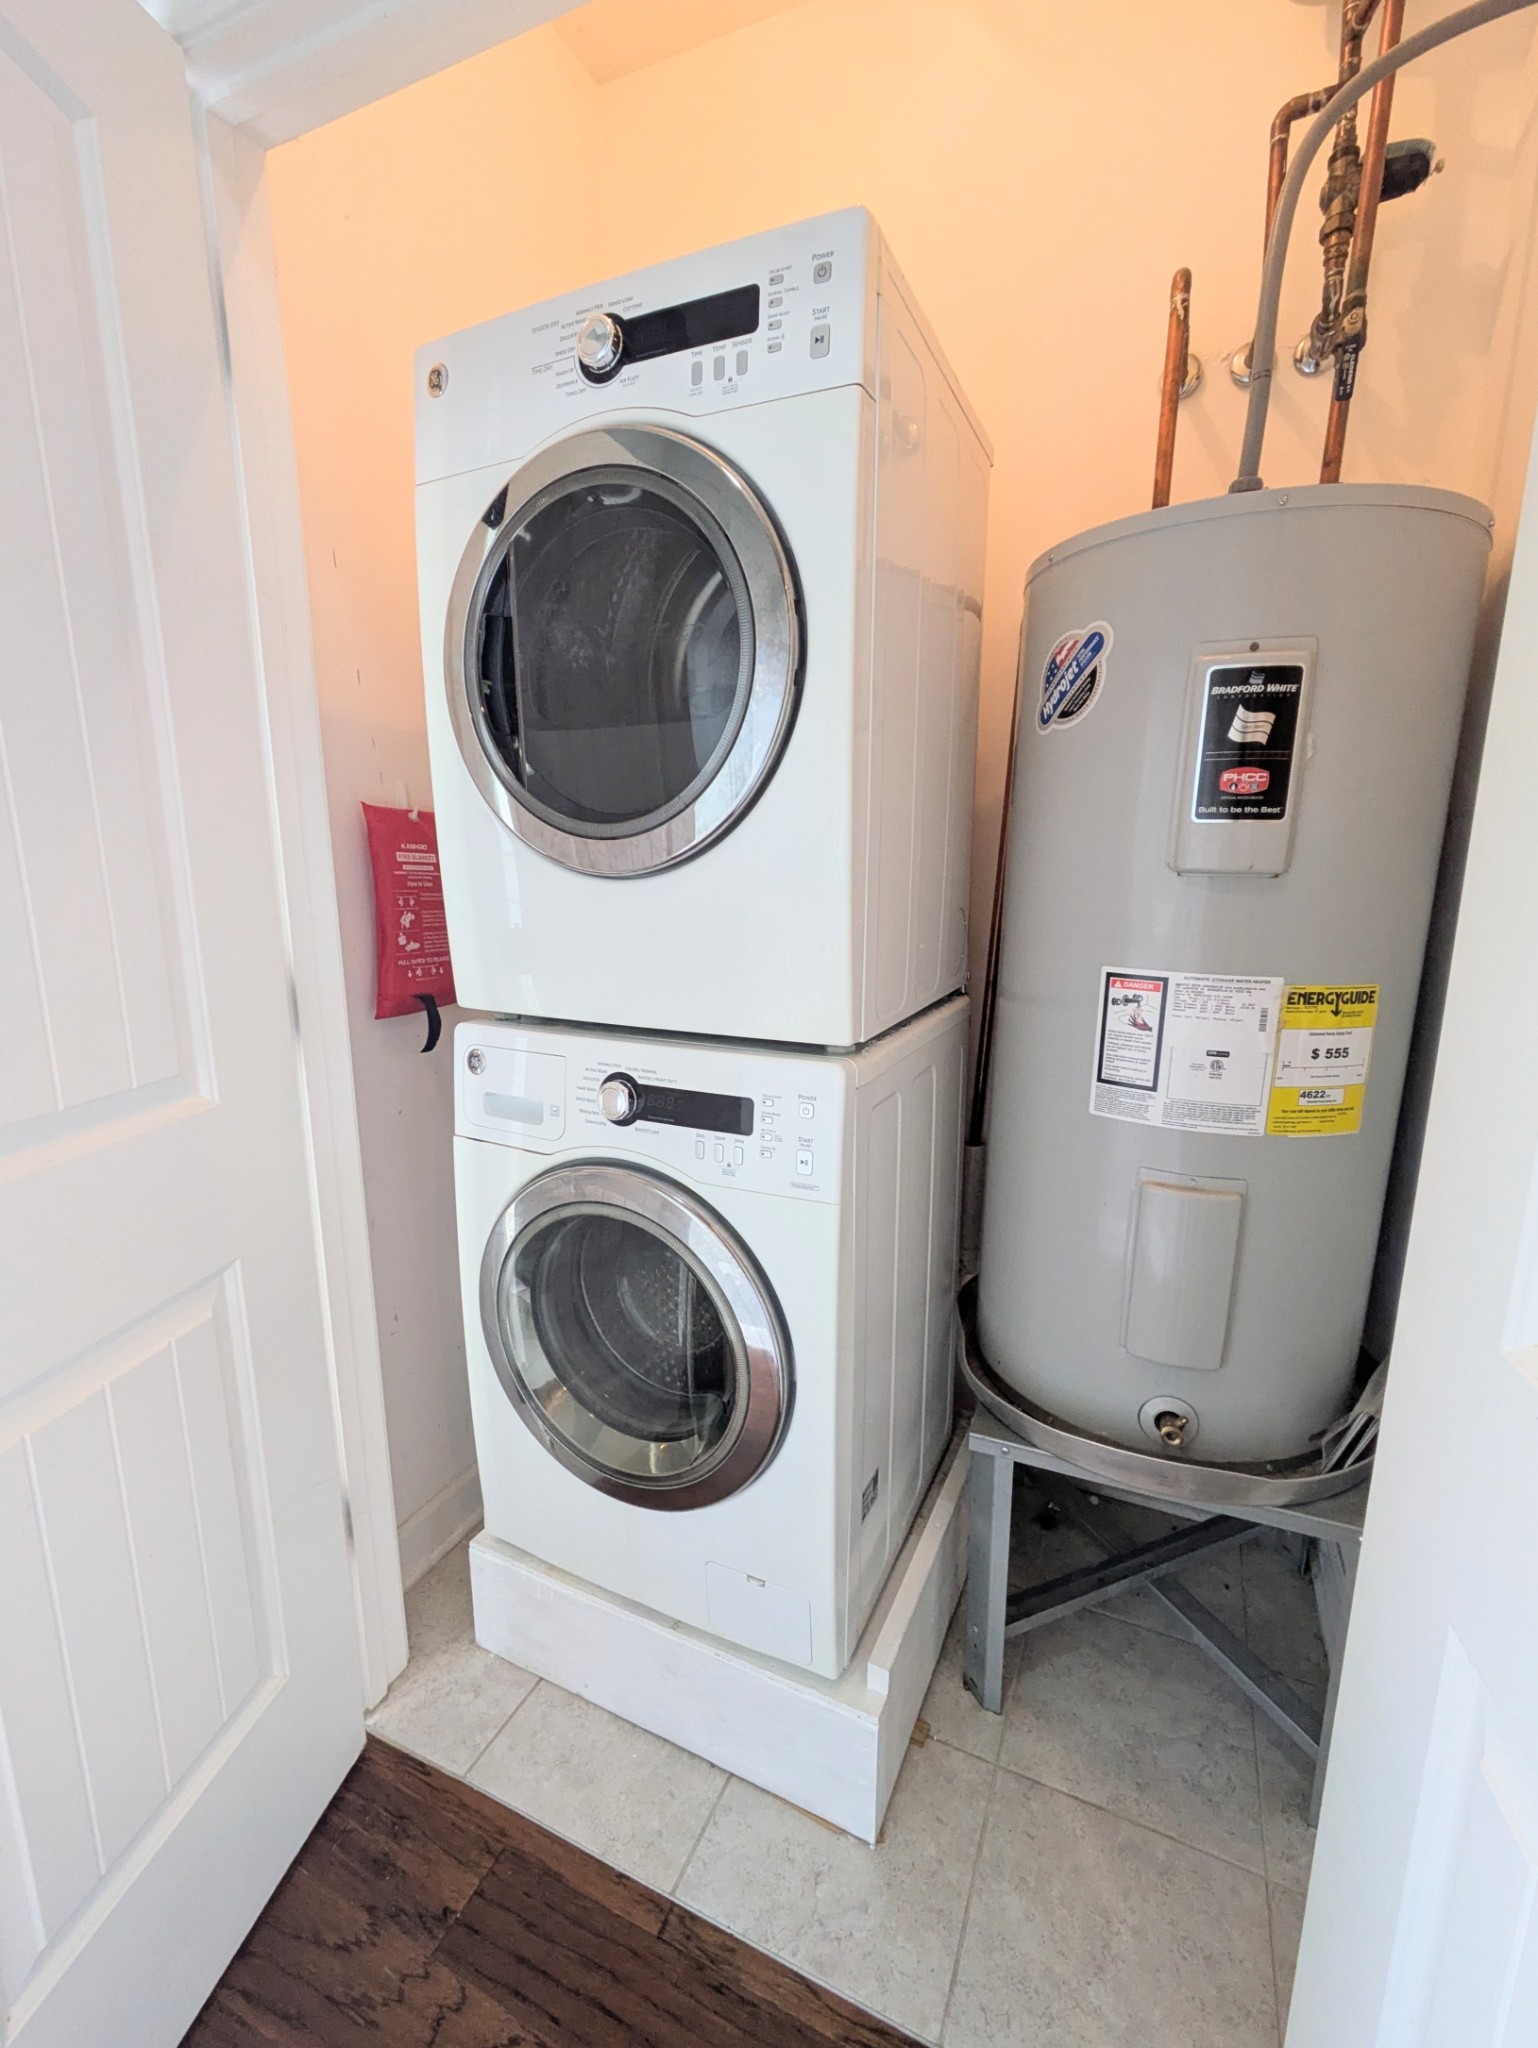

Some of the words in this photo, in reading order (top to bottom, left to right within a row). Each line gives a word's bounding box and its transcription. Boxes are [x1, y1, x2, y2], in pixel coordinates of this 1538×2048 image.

[811, 250, 834, 261] POWER
[812, 306, 830, 316] START
[561, 321, 574, 329] ACTIVE
[713, 344, 726, 352] TEMP
[732, 337, 752, 349] SENSOR
[691, 350, 703, 358] TIME
[1042, 660, 1079, 720] Hydrojet
[1210, 685, 1265, 695] BRADFORD
[1266, 683, 1298, 693] WHITE
[1222, 772, 1268, 782] PHCC
[1123, 980, 1154, 990] DANGER
[1287, 990, 1377, 1006] ENERGYGUIDE
[1311, 1048, 1320, 1060] $
[1324, 1047, 1349, 1059] 555
[1299, 1090, 1326, 1099] 4622
